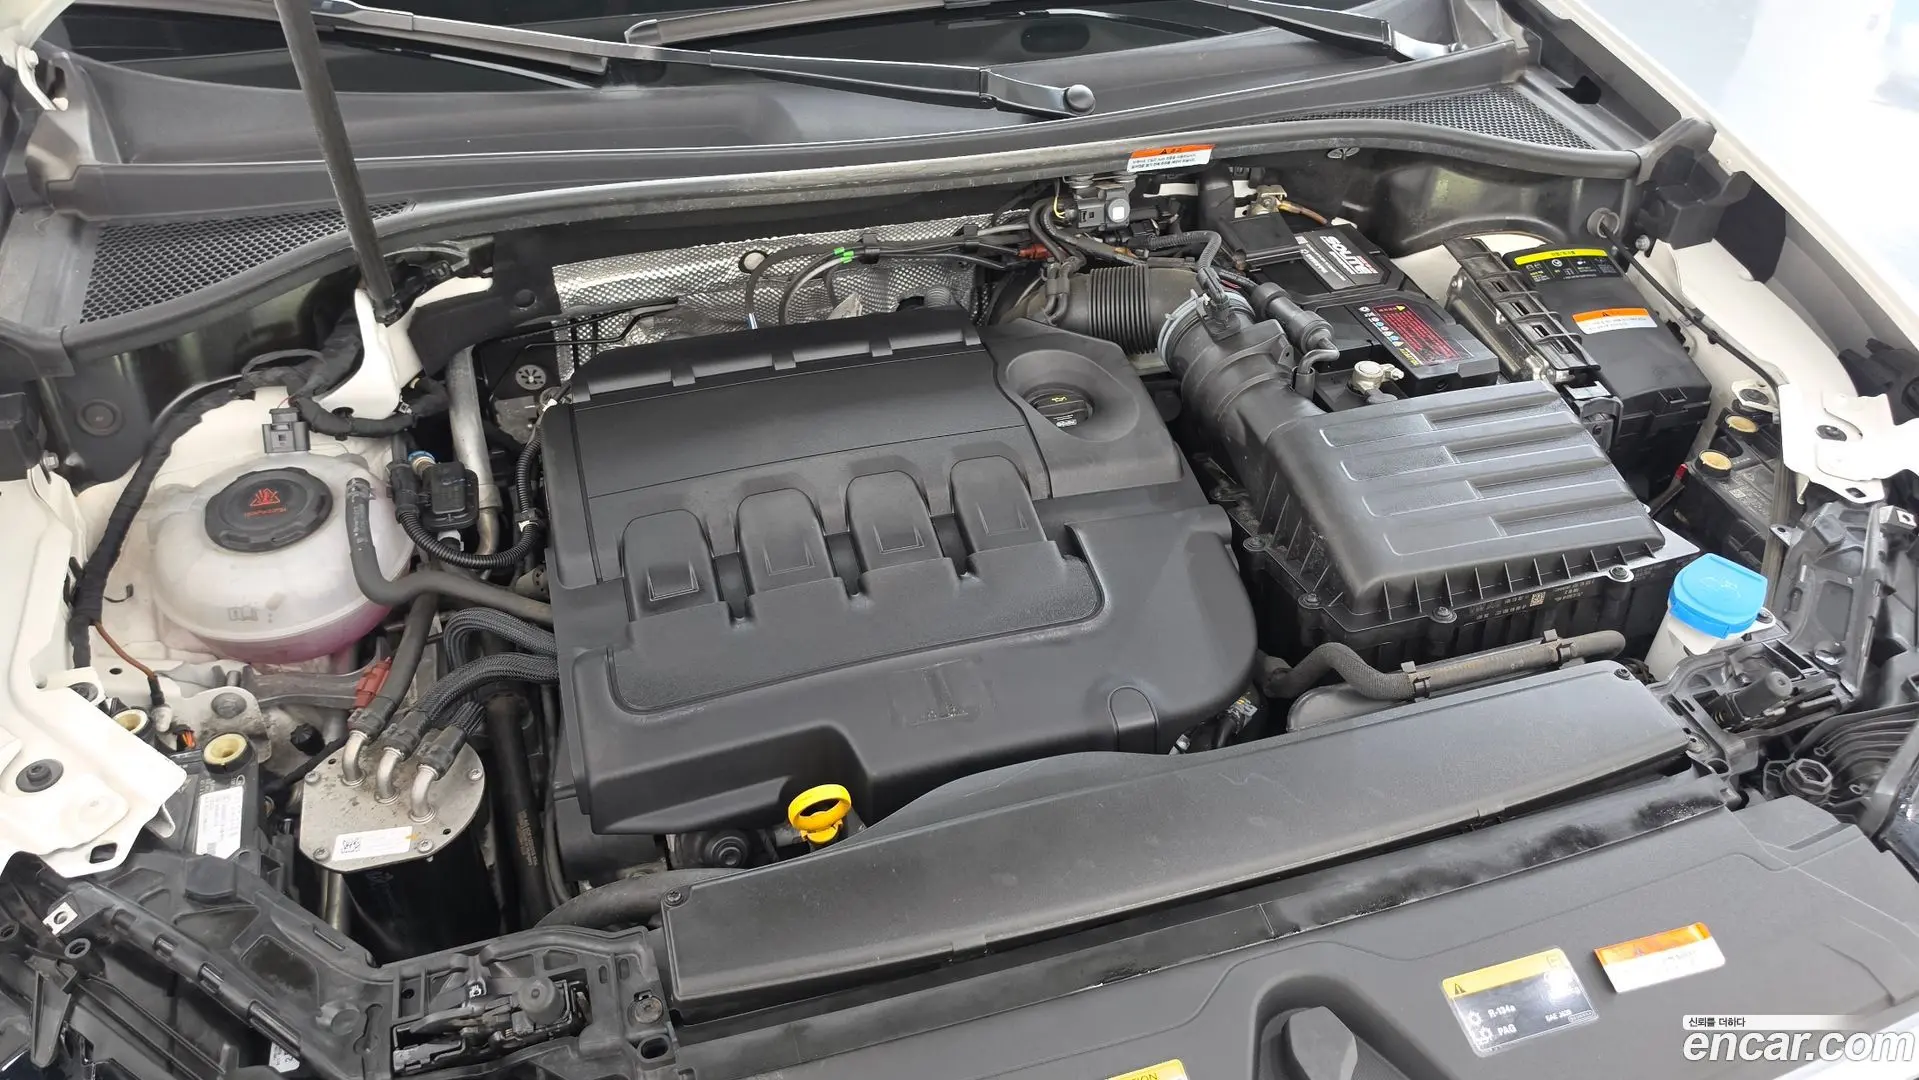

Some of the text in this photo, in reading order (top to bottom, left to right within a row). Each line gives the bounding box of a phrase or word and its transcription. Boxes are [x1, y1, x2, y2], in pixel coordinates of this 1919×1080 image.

[1321, 236, 1372, 274] SOLITE
[1488, 1004, 1516, 1018] R-134a
[1497, 1023, 1517, 1036] PAG
